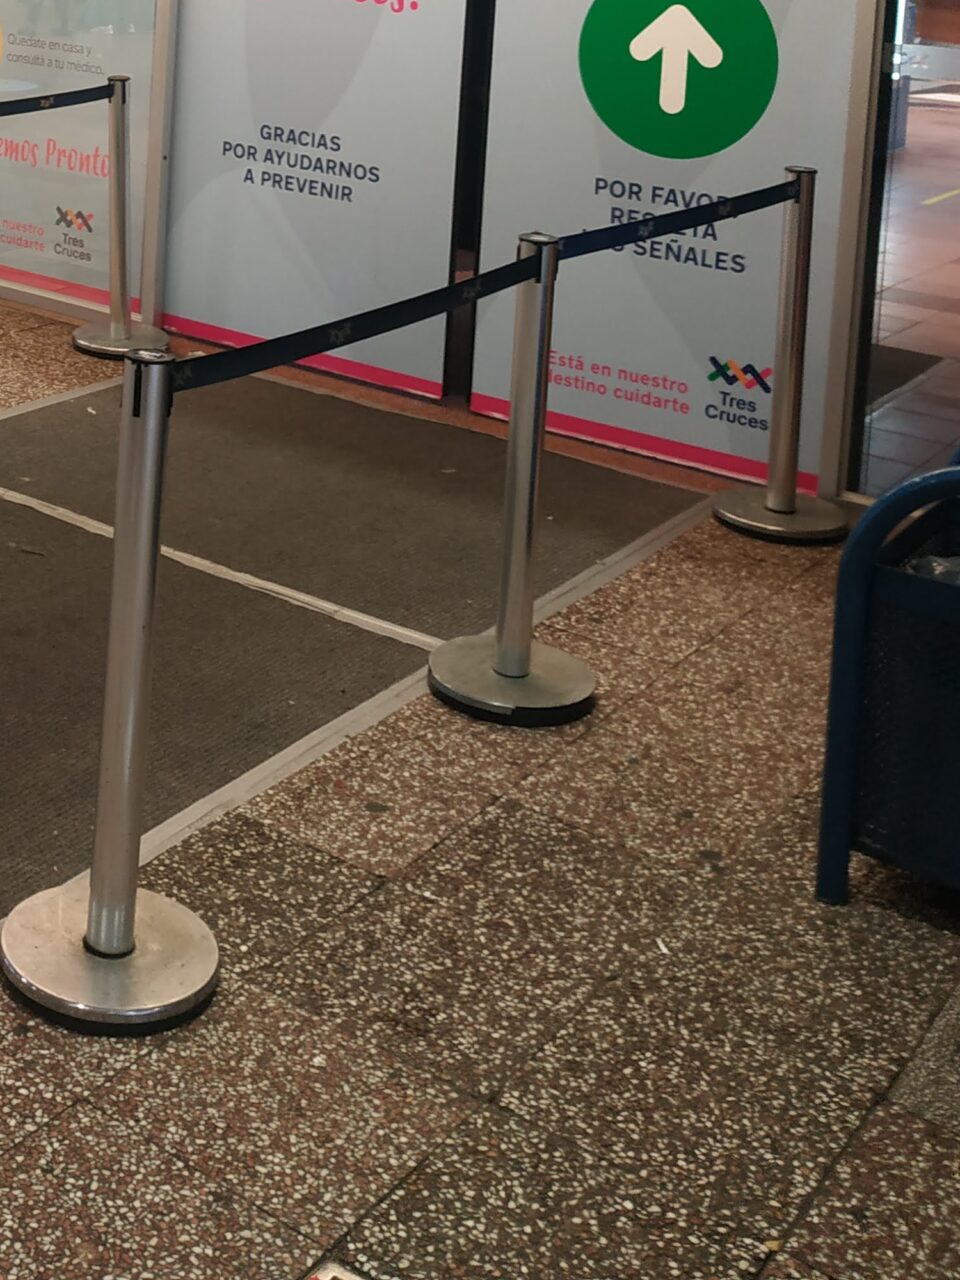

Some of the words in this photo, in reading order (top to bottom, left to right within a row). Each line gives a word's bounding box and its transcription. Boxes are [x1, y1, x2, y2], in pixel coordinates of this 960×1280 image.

[259, 124, 341, 153] GRACIAS
[222, 140, 258, 163] POR
[263, 148, 381, 183] AYUDARNOS
[243, 168, 255, 185] A
[261, 171, 354, 203] PREVENIR
[594, 177, 643, 202] POR
[0, 232, 45, 253] cuidarte
[1, 219, 45, 238] nuestro
[61, 232, 84, 249] Tres
[53, 243, 92, 263] Cruces
[633, 238, 746, 274] SEÑALES
[548, 349, 585, 371] Está
[590, 362, 612, 377] en
[618, 367, 688, 395] nuestro
[613, 385, 691, 415] cuidarte
[719, 390, 757, 413] Tres
[704, 403, 769, 431] Cruces
